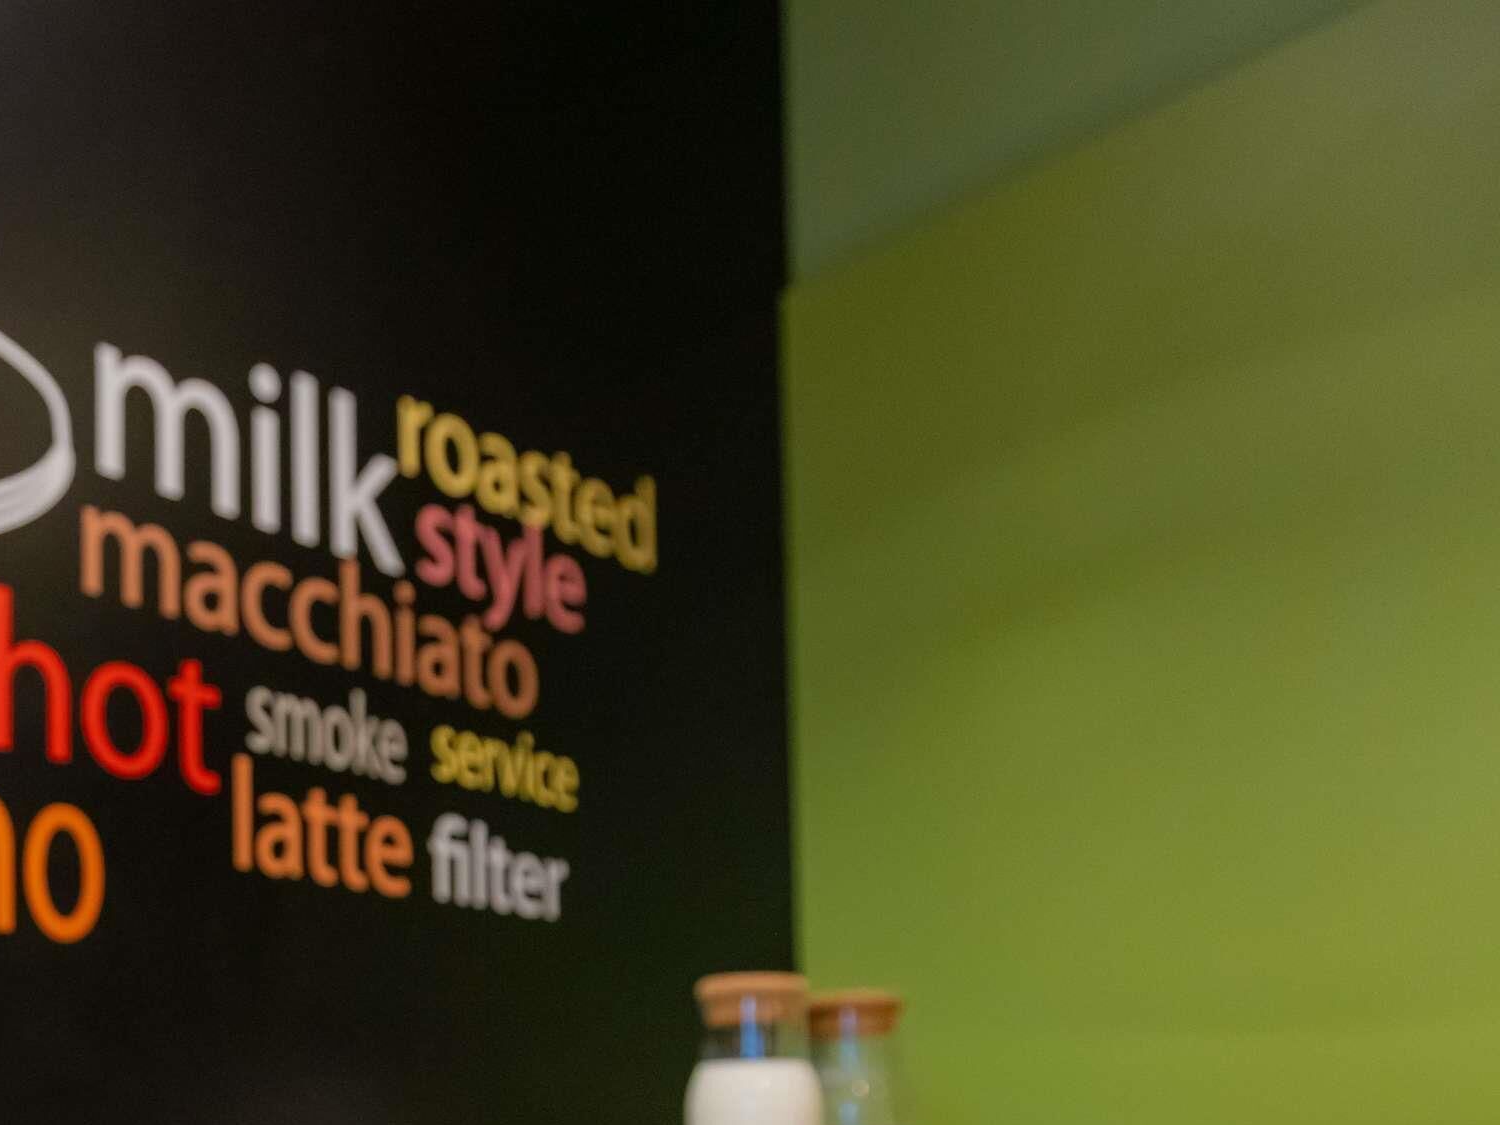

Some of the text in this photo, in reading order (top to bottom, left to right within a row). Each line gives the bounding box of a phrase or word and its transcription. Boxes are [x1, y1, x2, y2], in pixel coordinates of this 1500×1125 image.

[94, 341, 403, 577] milk
[397, 395, 658, 575] roasted
[79, 505, 541, 718] macchiato
[415, 504, 588, 634] style
[245, 685, 409, 786] smoke
[430, 725, 580, 813] service
[231, 753, 414, 900] latte
[428, 812, 569, 922] filter
